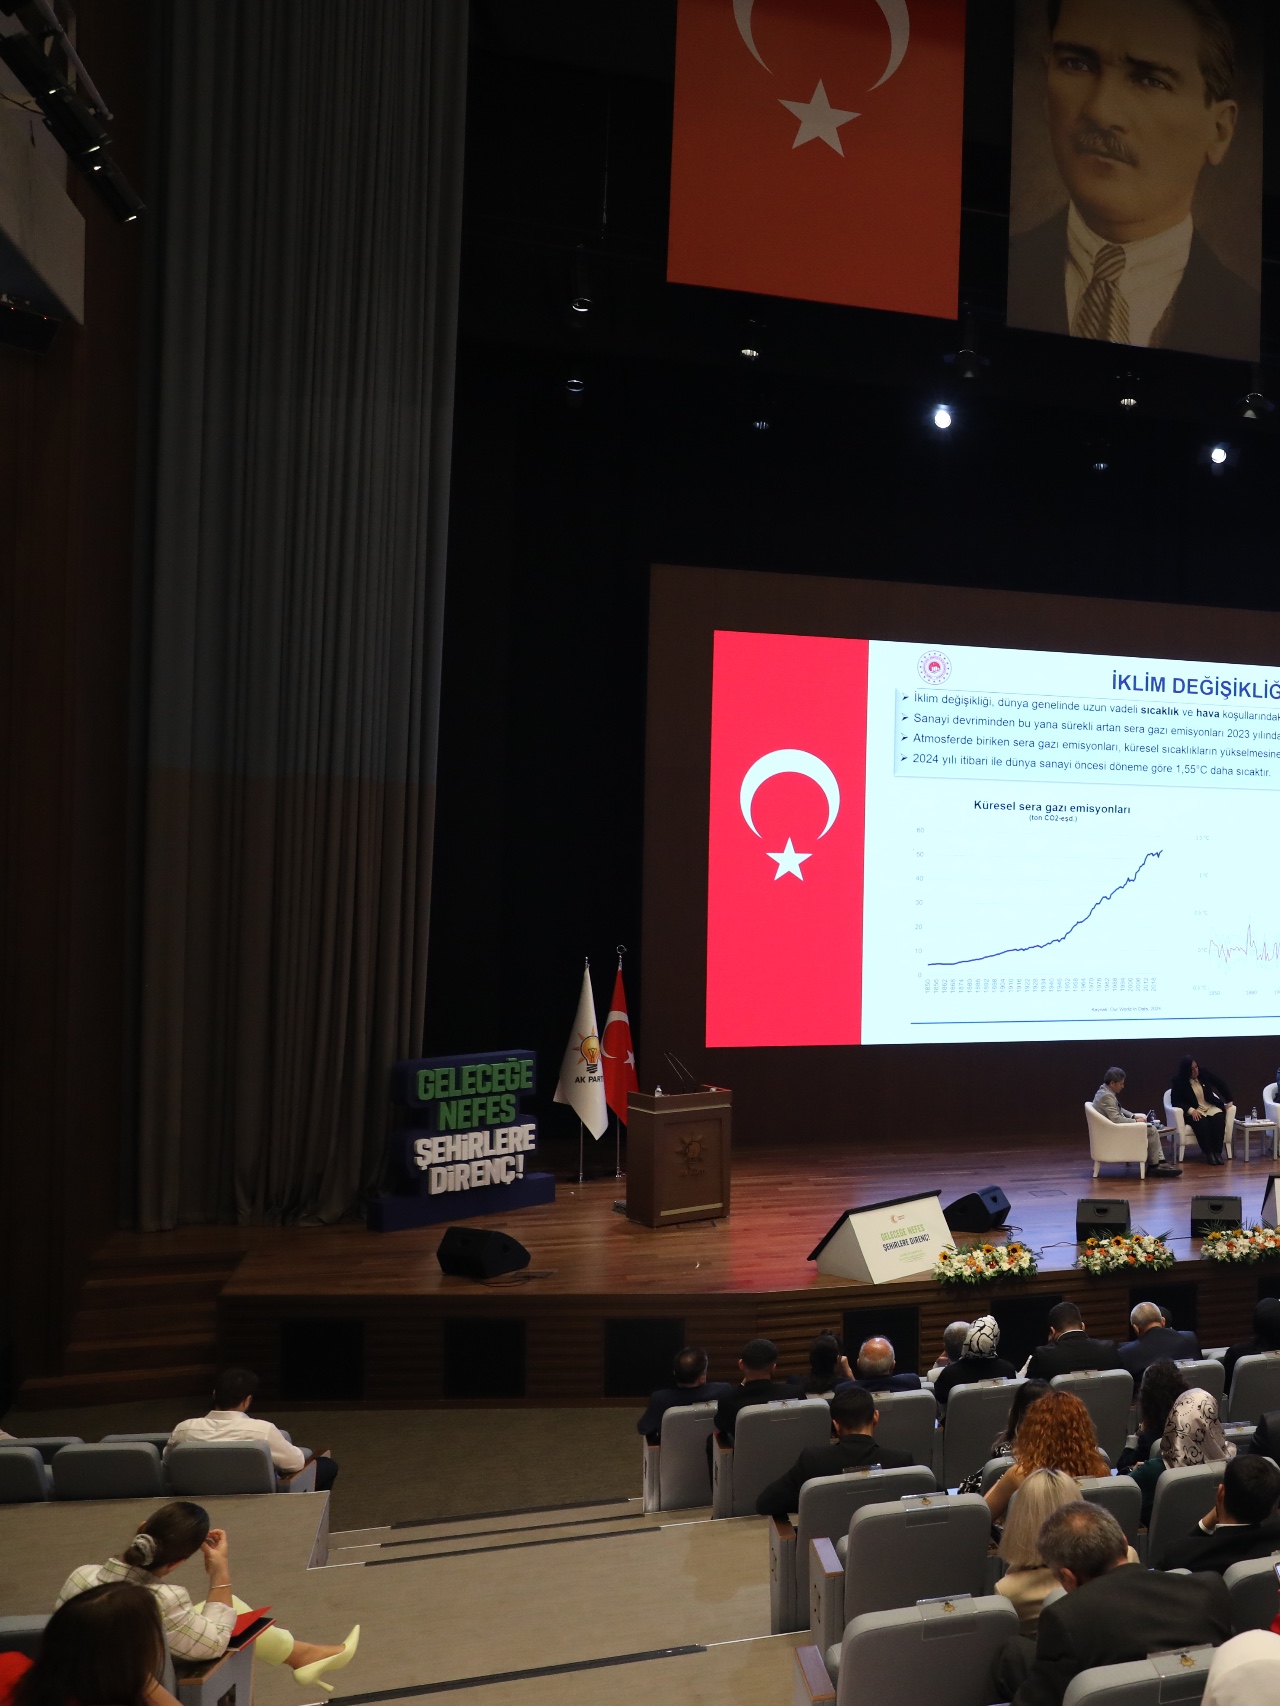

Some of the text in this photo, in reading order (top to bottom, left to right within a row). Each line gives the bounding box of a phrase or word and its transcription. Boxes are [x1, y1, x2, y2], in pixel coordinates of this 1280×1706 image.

[1112, 669, 1165, 692] İKLİM
[914, 690, 938, 703] İklim
[941, 694, 994, 707] değişikliği,
[997, 697, 1028, 709] dünya
[1031, 700, 1080, 710] genelinde
[1109, 704, 1137, 713] vadeli
[1140, 706, 1179, 715] sıcaklık
[1196, 708, 1219, 718] hava
[913, 712, 949, 725] Sanayi
[952, 715, 1015, 726] devriminden
[1018, 718, 1030, 727] bu
[1033, 721, 1058, 730] yana
[1061, 720, 1093, 730] sürekli
[1095, 722, 1120, 731] artan
[1147, 726, 1167, 735] gazı
[1170, 726, 1223, 737] emisyonları
[1227, 728, 1249, 738] 2023
[912, 732, 973, 744] Atmosferde
[976, 735, 1009, 746] biriken
[1012, 739, 1034, 747] sera
[1037, 740, 1058, 750] gazı
[1062, 740, 1120, 752] emisyonları,
[1124, 742, 1158, 752] küresel
[1161, 745, 1217, 755] sıcaklıkların
[912, 753, 1270, 776] 2024 yılı itibari ile dünya sanayi öncesi döneme göre 1,55°C daha sıcaktır.
[974, 800, 1131, 815] Küresel sera gazı emisyonları
[416, 1057, 534, 1101] GELECEĞE
[438, 1095, 516, 1131] NEFES
